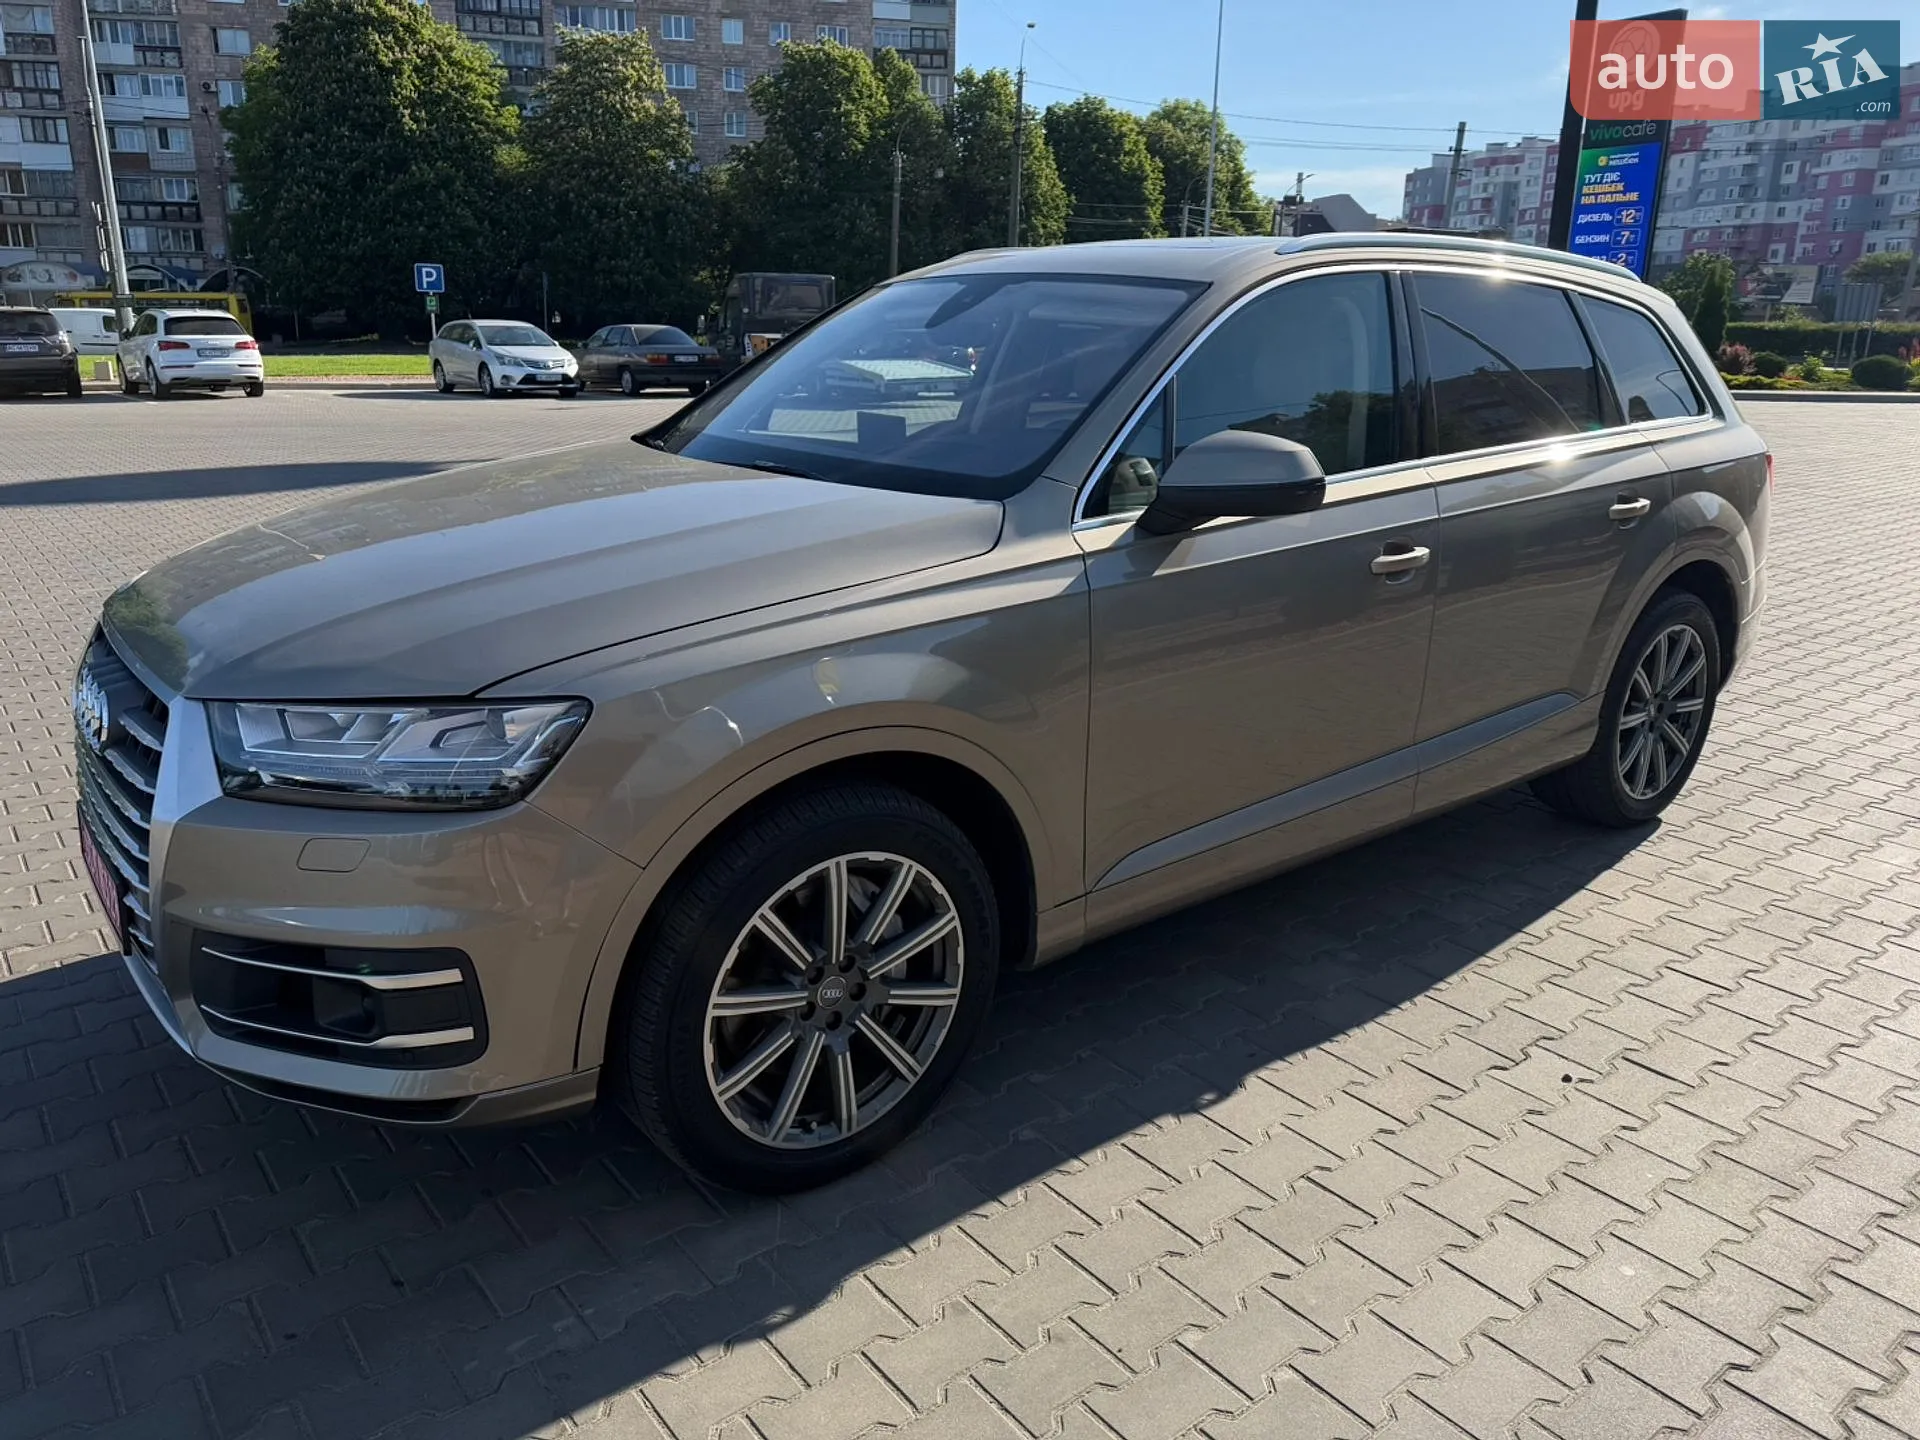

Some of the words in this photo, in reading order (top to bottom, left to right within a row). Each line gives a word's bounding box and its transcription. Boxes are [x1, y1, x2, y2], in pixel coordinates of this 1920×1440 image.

[1608, 89, 1646, 113] upg
[1585, 174, 1602, 183] ТУТ
[1602, 172, 1621, 182] ДІЄ
[1582, 195, 1595, 204] НА
[1598, 192, 1639, 203] ПАЛЬНЕ
[1577, 213, 1612, 223] ДИЗЕЛЬ
[1576, 234, 1609, 244] БЕНЗИН
[422, 268, 436, 288] P
